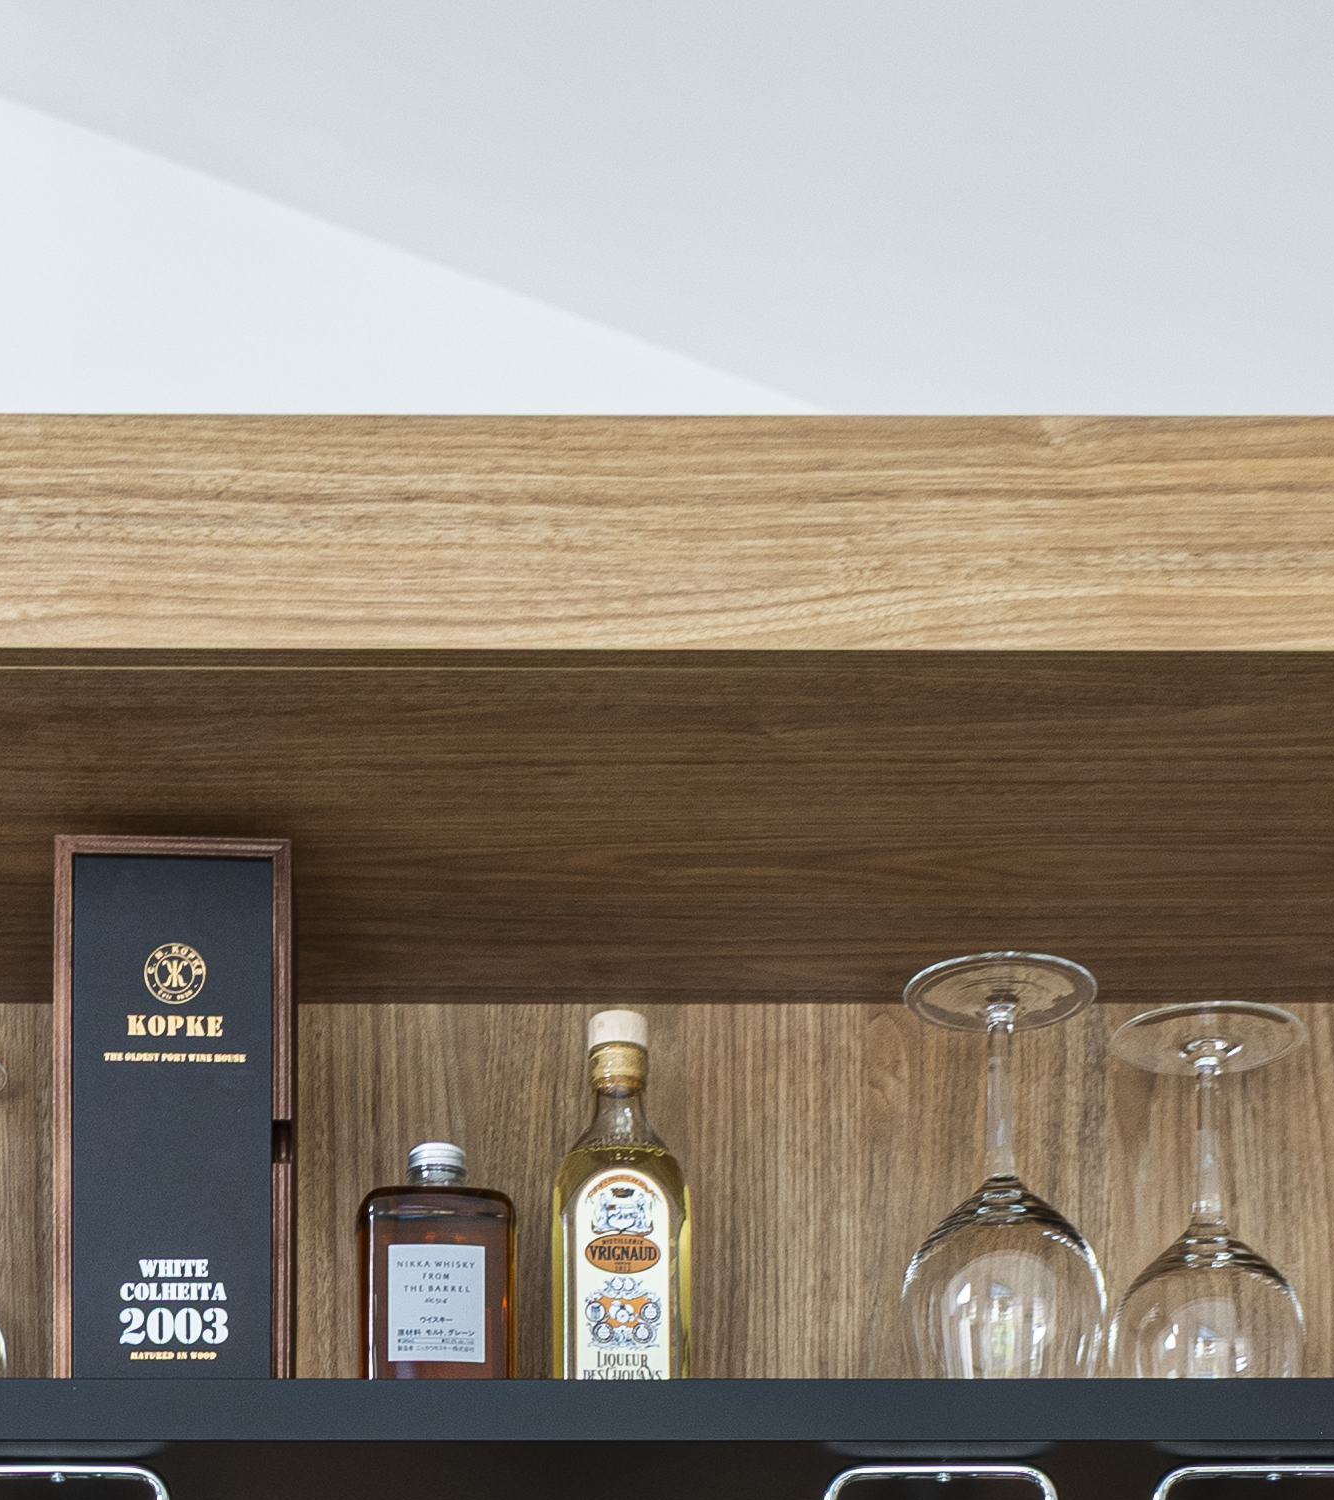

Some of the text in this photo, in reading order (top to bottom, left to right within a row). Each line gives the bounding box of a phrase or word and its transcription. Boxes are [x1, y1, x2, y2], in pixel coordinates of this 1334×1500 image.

[127, 1014, 223, 1037] KOPKE
[104, 1051, 247, 1064] THE OLDEST PORT WINE HOUSE
[589, 1246, 658, 1262] VRIGNAUD
[138, 1258, 209, 1278] WHITE
[434, 1261, 476, 1269] WHISKY
[120, 1282, 228, 1302] COLHEITA
[404, 1285, 471, 1293] THE BARREL
[119, 1307, 229, 1345] 2003
[130, 1351, 217, 1360] MATURED IN WOOD
[597, 1350, 649, 1368] LIQUEUR
